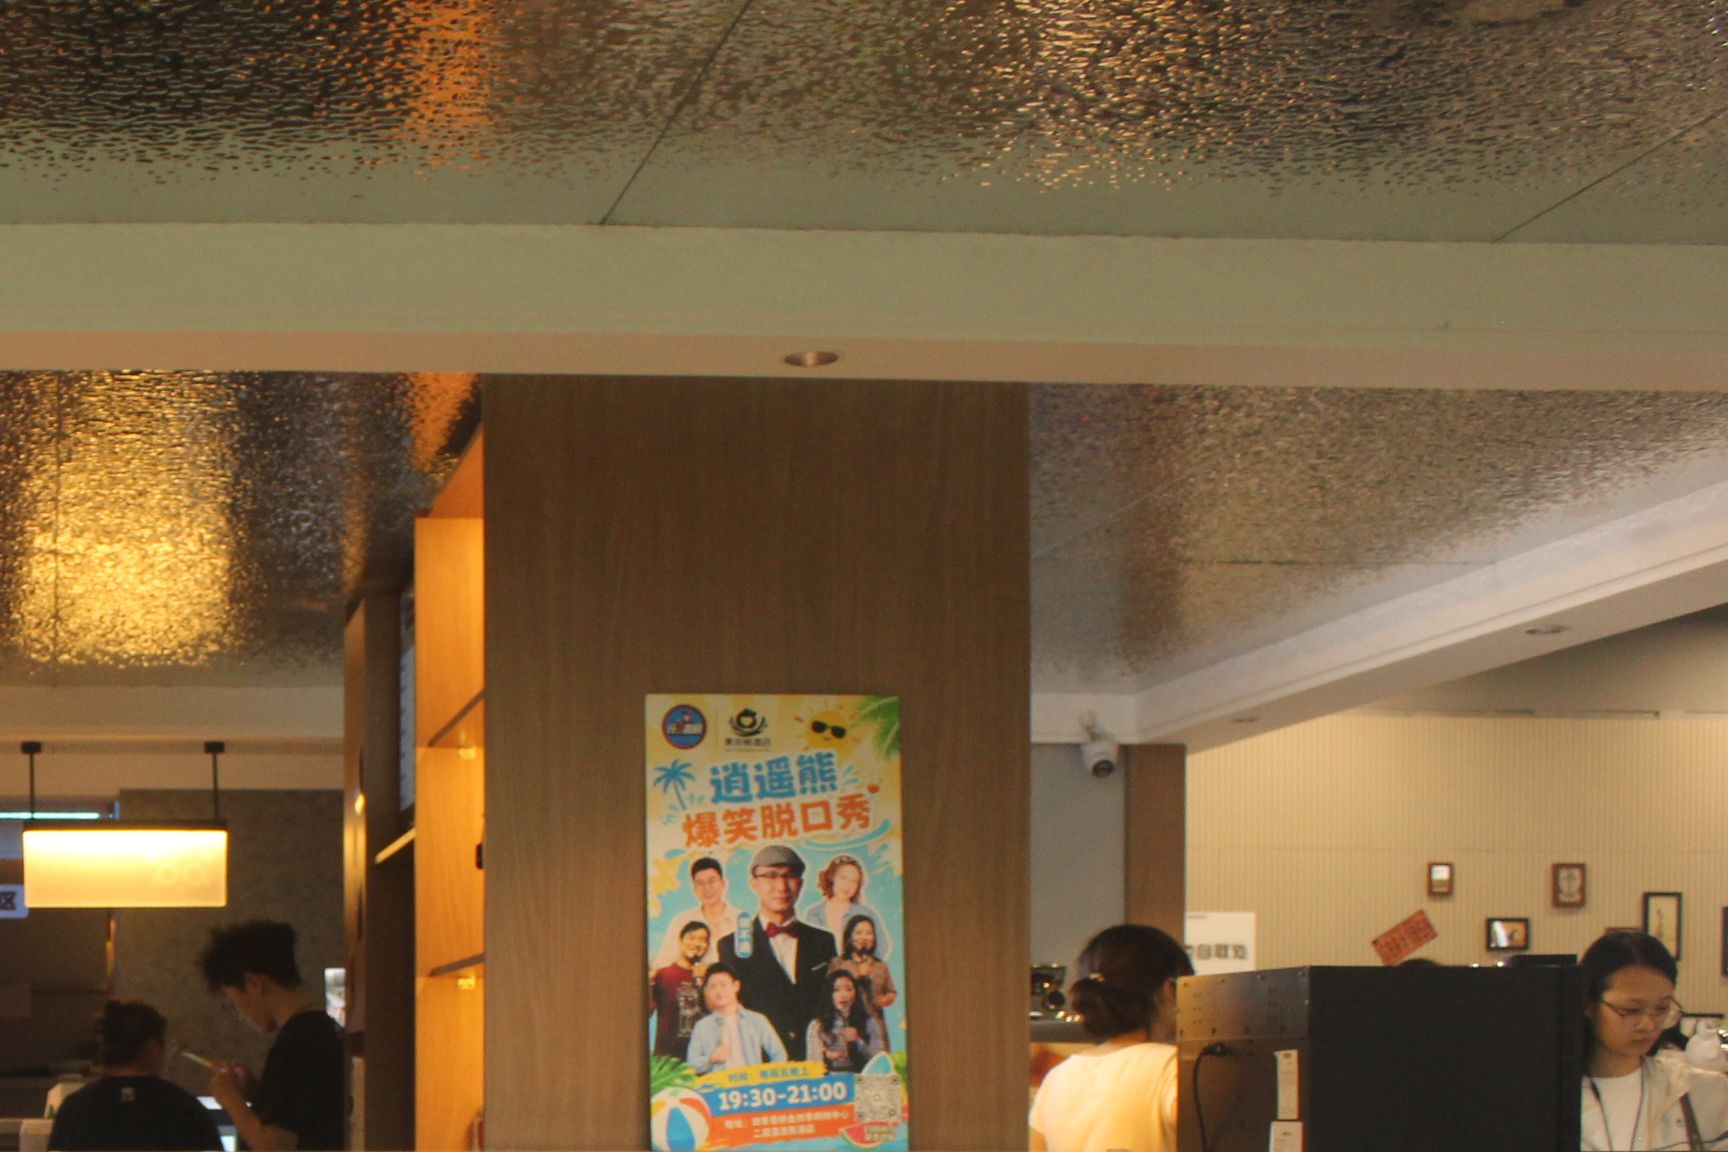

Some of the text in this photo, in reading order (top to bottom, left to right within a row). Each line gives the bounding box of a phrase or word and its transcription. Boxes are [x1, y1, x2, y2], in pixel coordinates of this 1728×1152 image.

[710, 752, 838, 804] 逍遥熊
[682, 793, 872, 849] 爆笑脱口秀
[719, 1081, 848, 1111] 19:30-21:00
